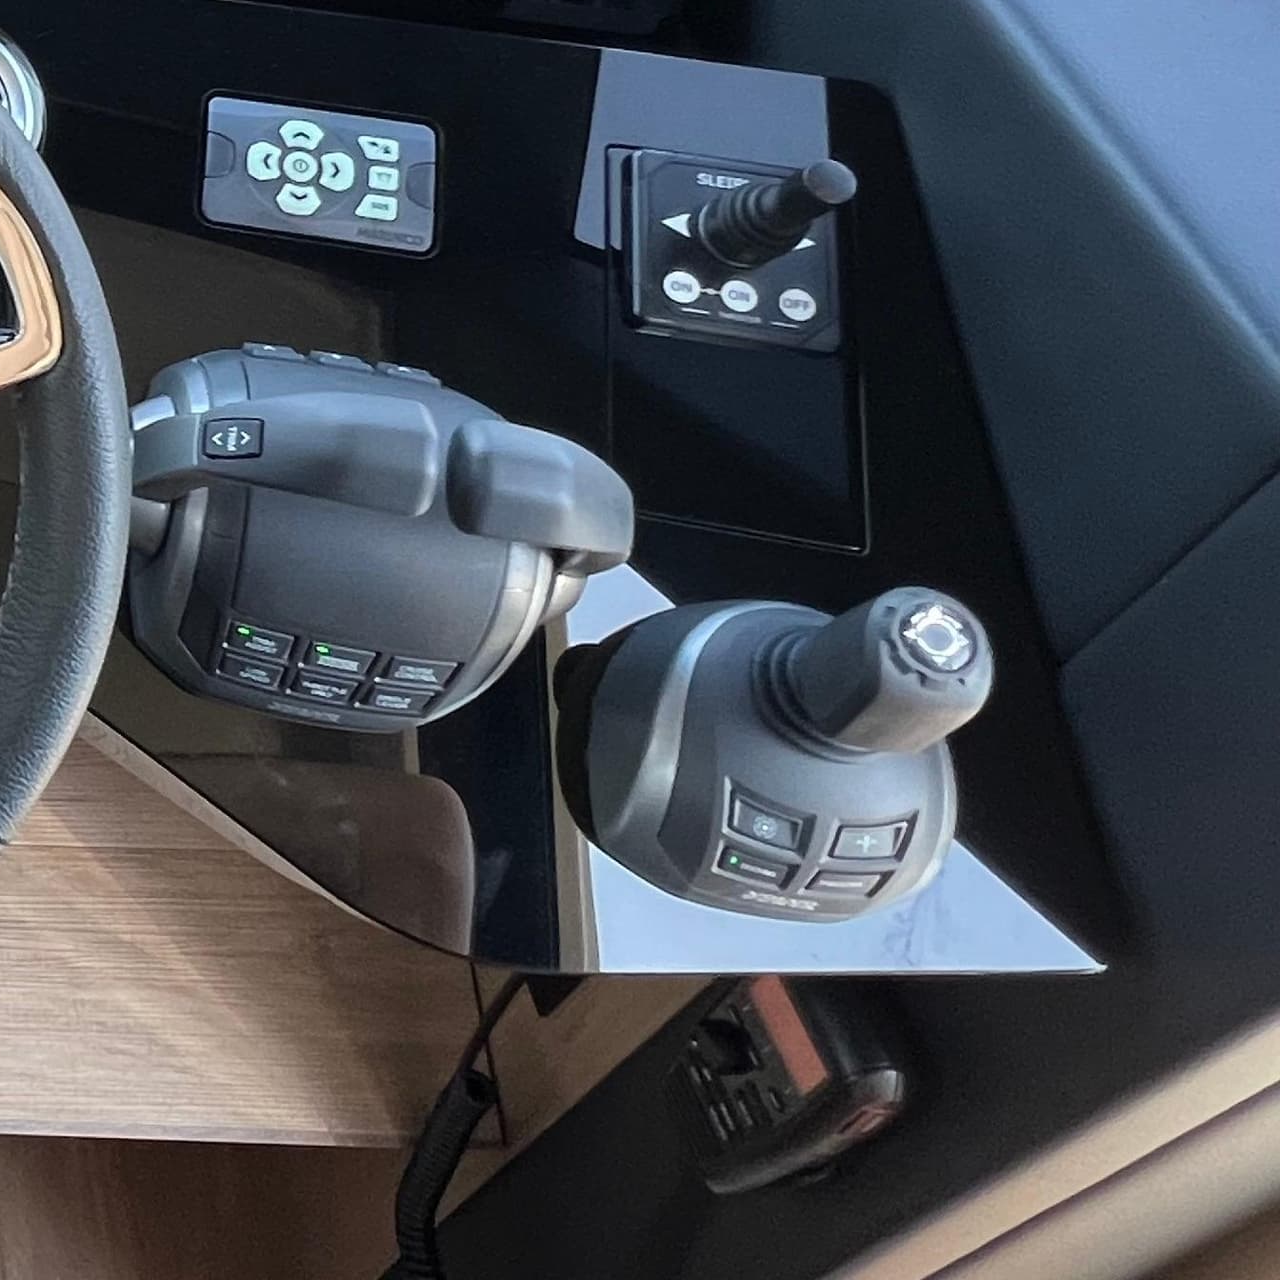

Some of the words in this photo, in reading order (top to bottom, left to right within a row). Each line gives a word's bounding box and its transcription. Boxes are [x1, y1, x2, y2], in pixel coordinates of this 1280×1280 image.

[669, 280, 693, 294] ON
[727, 289, 751, 303] ON
[782, 297, 810, 311] OFF
